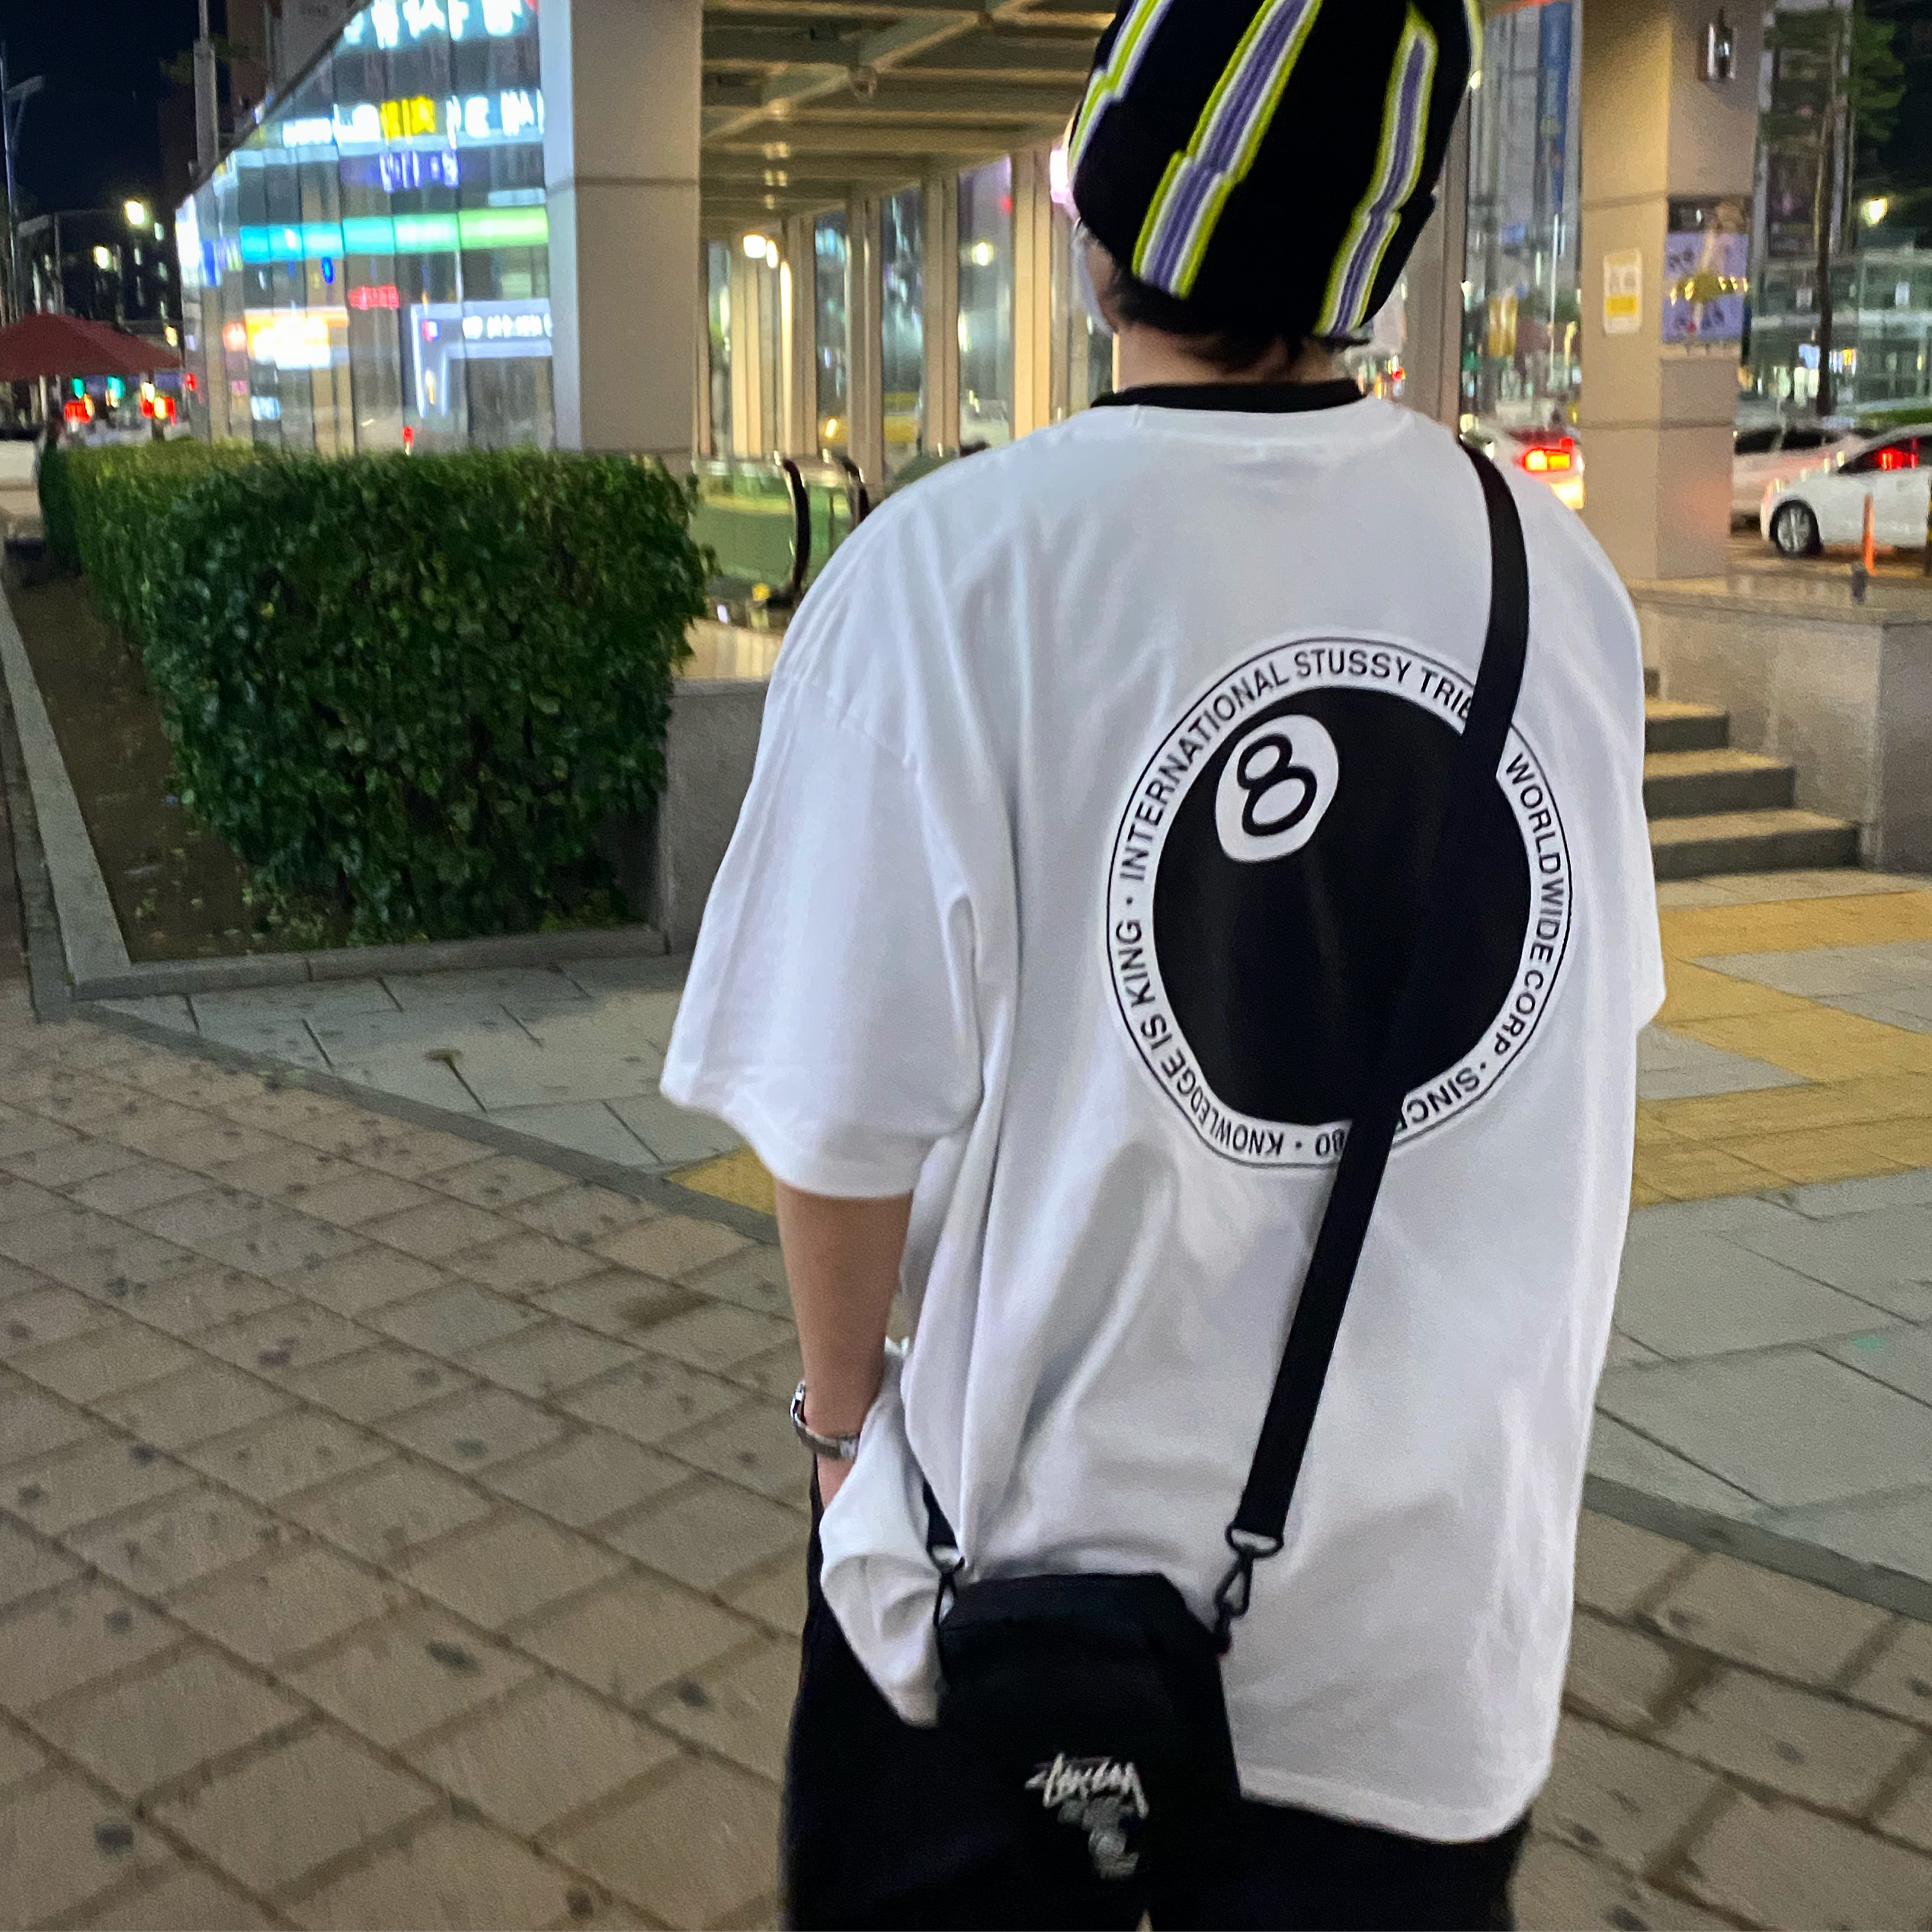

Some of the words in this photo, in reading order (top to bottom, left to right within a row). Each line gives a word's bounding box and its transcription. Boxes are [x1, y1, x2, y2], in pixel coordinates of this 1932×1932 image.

[1293, 649, 1412, 684] STUSSY
[1120, 662, 1290, 881] INTERNATIONAL
[1237, 732, 1318, 837] 8
[1506, 753, 1564, 964] WORLDWIDE
[1116, 919, 1156, 1008] KING
[1140, 1014, 1173, 1050] IS
[1494, 969, 1544, 1056] CORP
[1161, 1049, 1284, 1155] KNOWLEDGE
